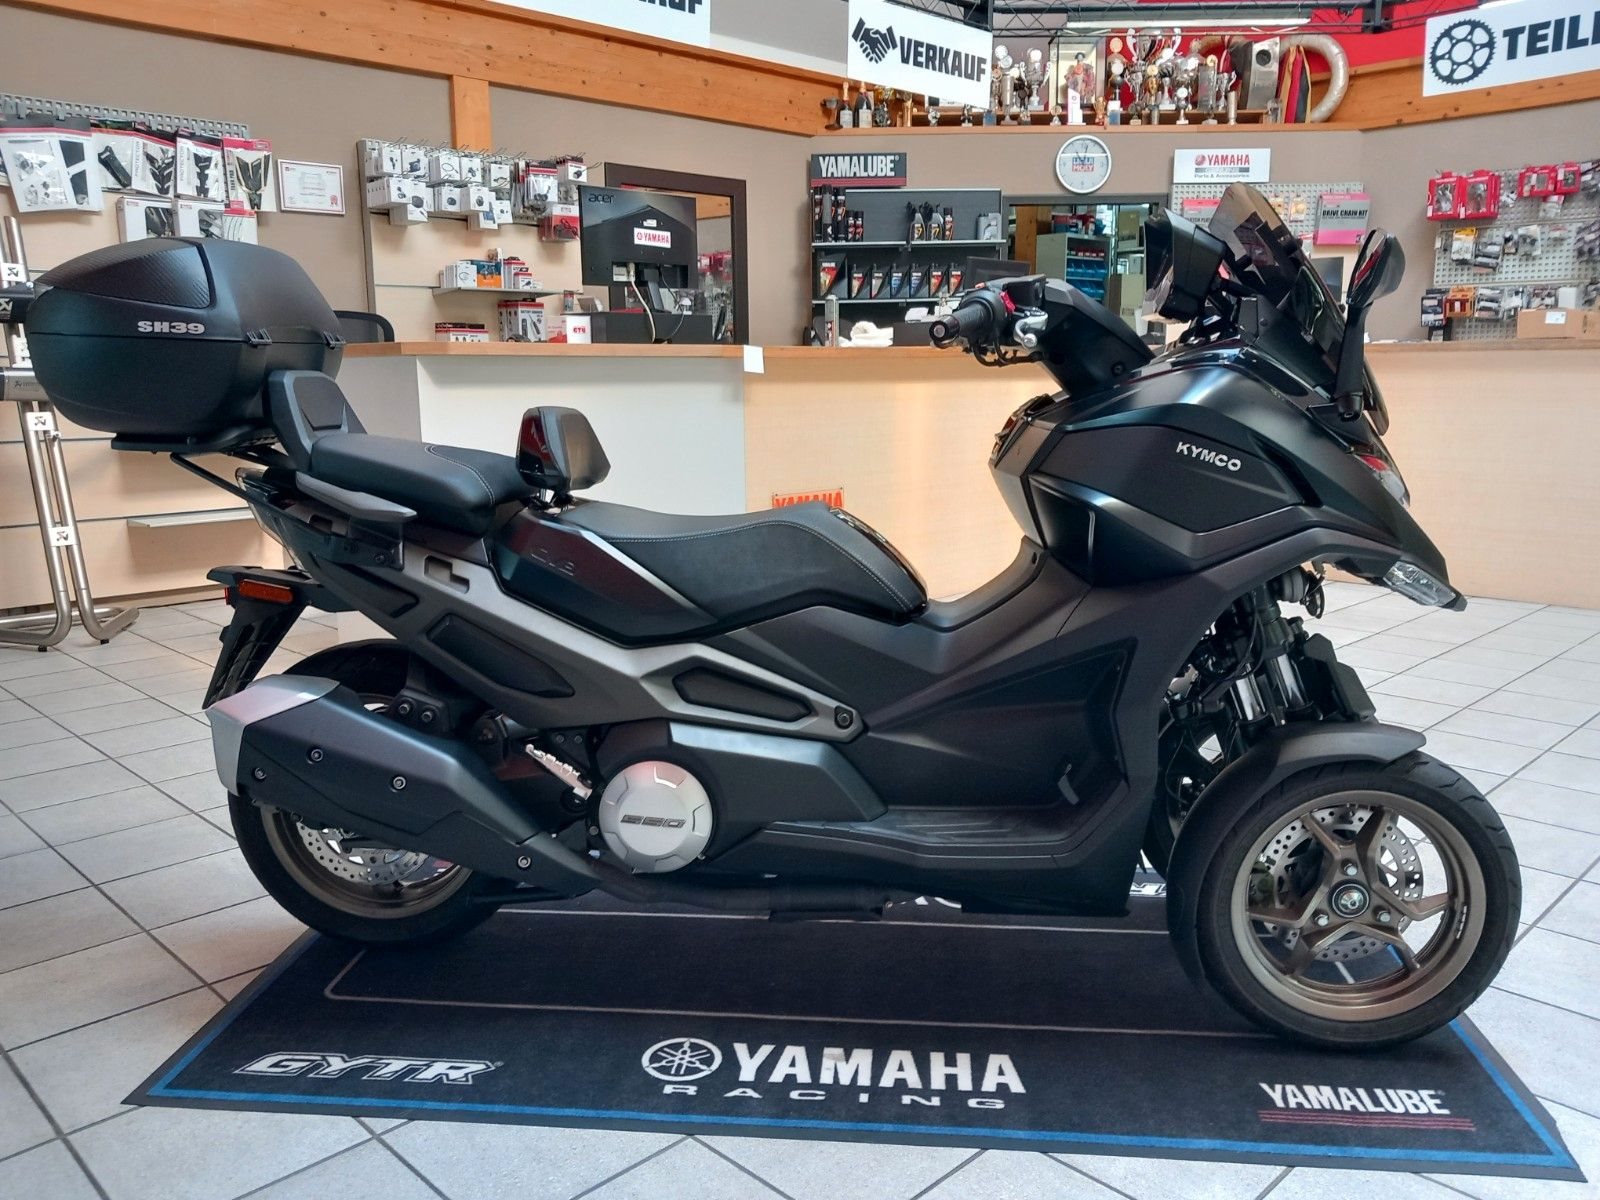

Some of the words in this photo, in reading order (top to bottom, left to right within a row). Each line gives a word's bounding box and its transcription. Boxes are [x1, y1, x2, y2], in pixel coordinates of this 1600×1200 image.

[899, 36, 987, 82] VERKAUF
[819, 155, 895, 177] YAMALUBE
[1207, 154, 1250, 166] YAMAHA
[588, 193, 614, 203] acer
[1322, 209, 1339, 217] DRIVE
[1340, 209, 1358, 217] CHAIN
[1359, 209, 1368, 217] KIT
[644, 232, 670, 244] YAMAHA
[137, 320, 206, 335] SH39
[1175, 441, 1242, 472] KYMCO
[233, 1052, 496, 1084] GYTR
[733, 1042, 1026, 1094] YAMAHA
[662, 1084, 1005, 1109] RACING
[1259, 1082, 1451, 1115] YAMALUBE
